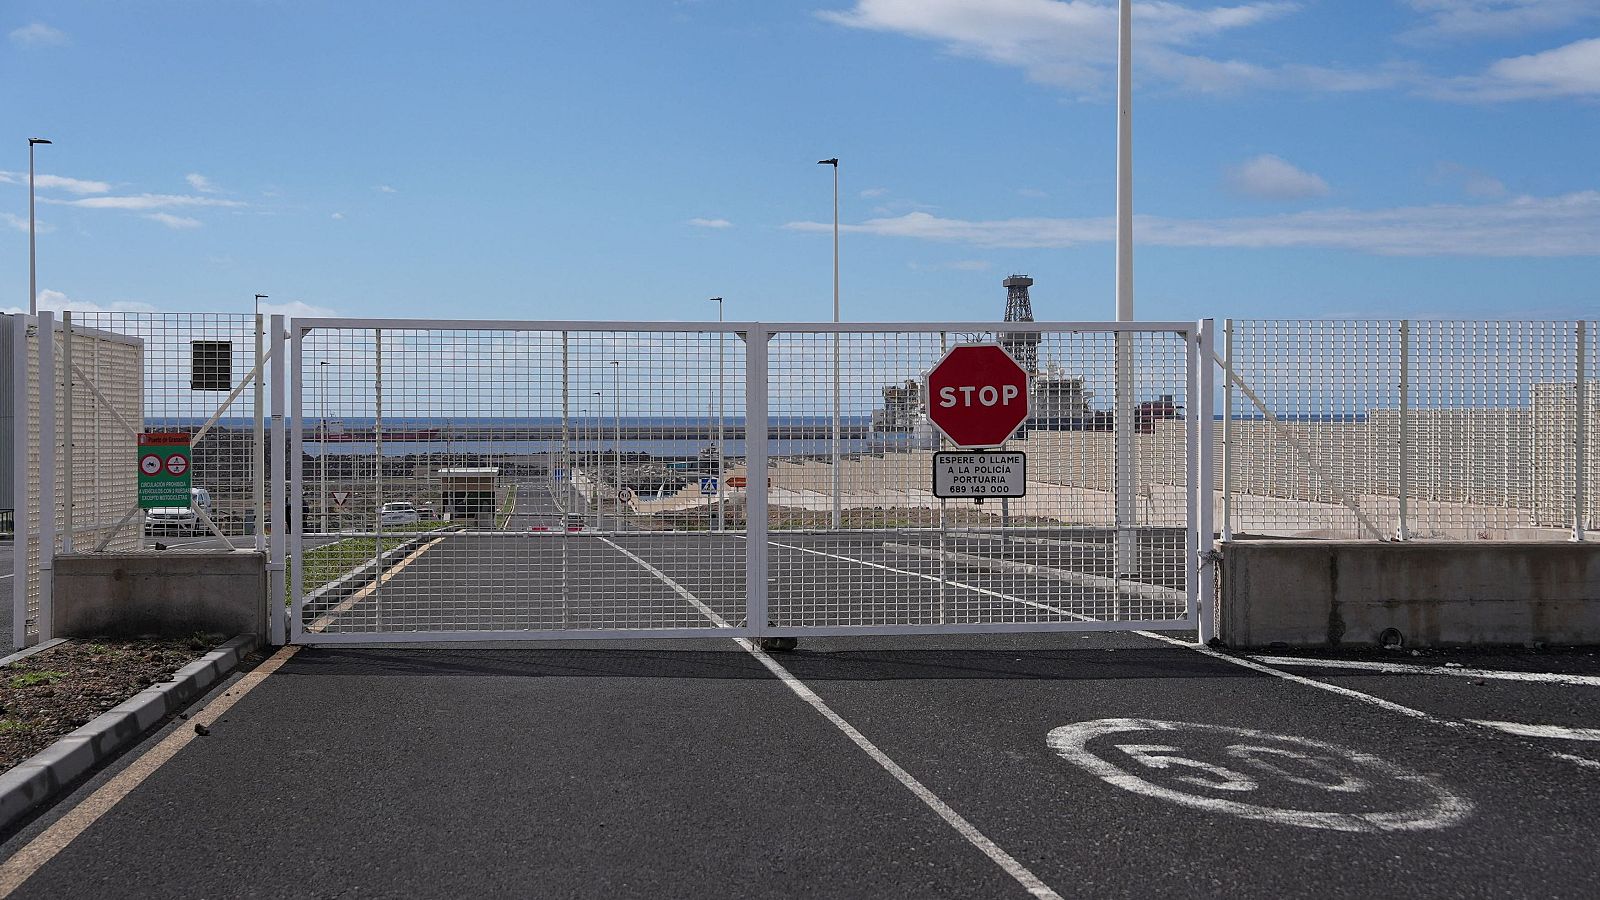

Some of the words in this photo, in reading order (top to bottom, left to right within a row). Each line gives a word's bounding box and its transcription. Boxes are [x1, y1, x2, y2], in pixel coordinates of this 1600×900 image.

[940, 384, 1018, 408] STOP
[939, 456, 975, 464] ESPERE
[978, 456, 986, 464] O
[990, 456, 1020, 464] LLAME
[947, 466, 954, 474] A
[958, 466, 970, 474] LA
[974, 465, 1011, 474] POLICÍA
[953, 476, 1006, 484] PORTUARIA
[949, 485, 966, 493] 689
[970, 485, 986, 493] 143
[990, 485, 1009, 493] 000
